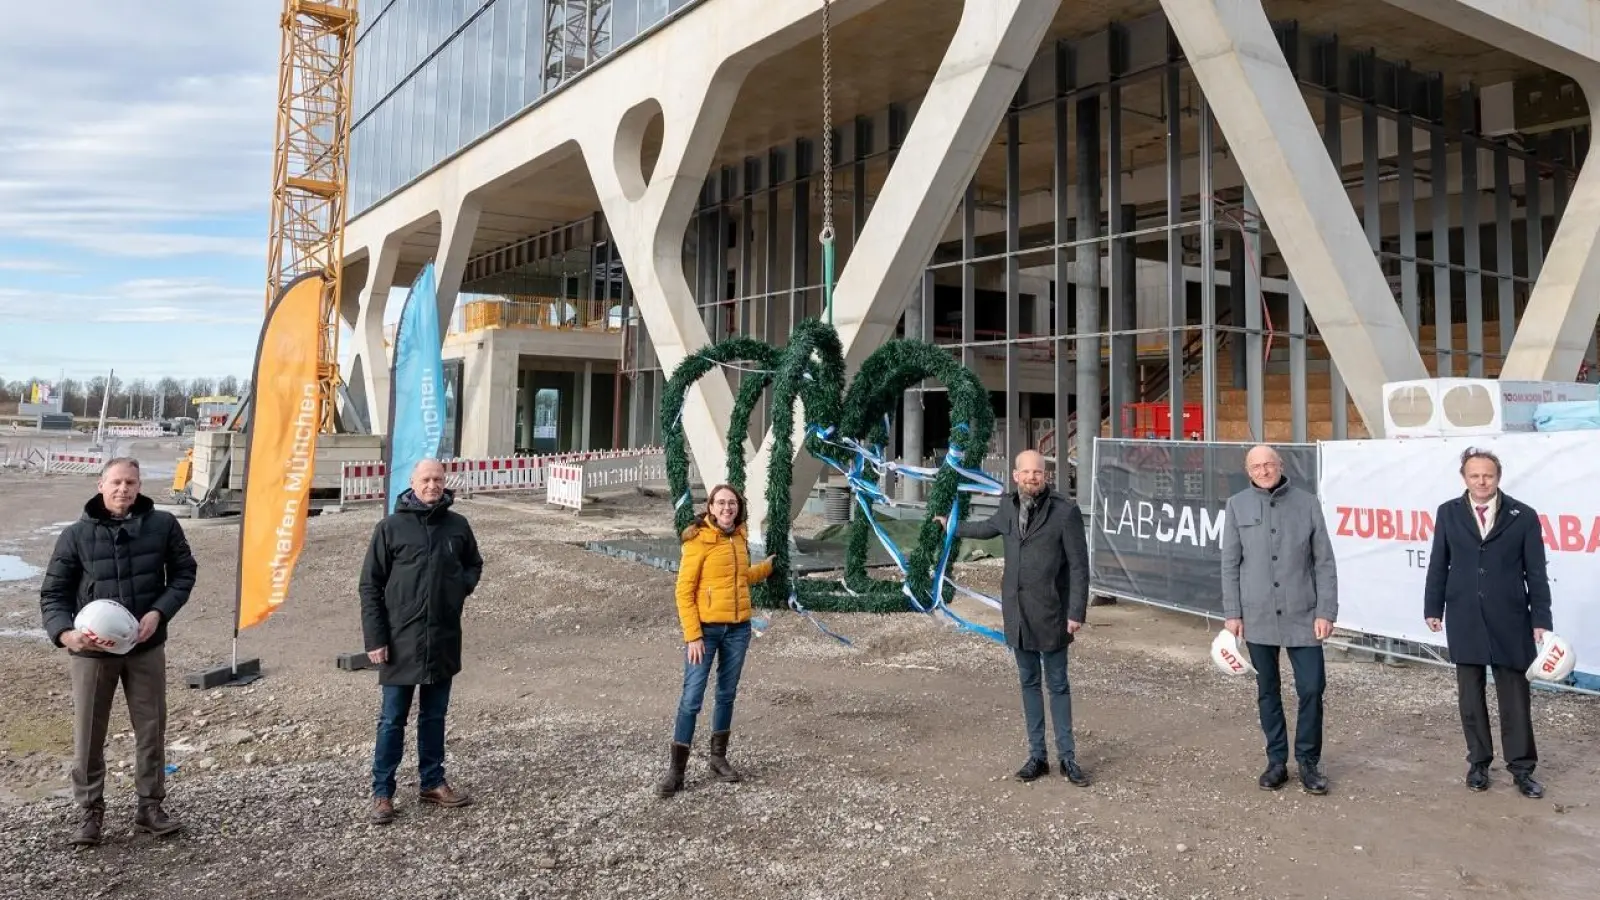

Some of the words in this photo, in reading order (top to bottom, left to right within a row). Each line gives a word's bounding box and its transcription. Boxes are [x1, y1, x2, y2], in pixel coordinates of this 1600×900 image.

[283, 383, 316, 492] München
[420, 368, 440, 458] ünchen
[1103, 497, 1226, 550] LABCAM
[1538, 514, 1600, 552] ABA
[1405, 549, 1426, 568] TE
